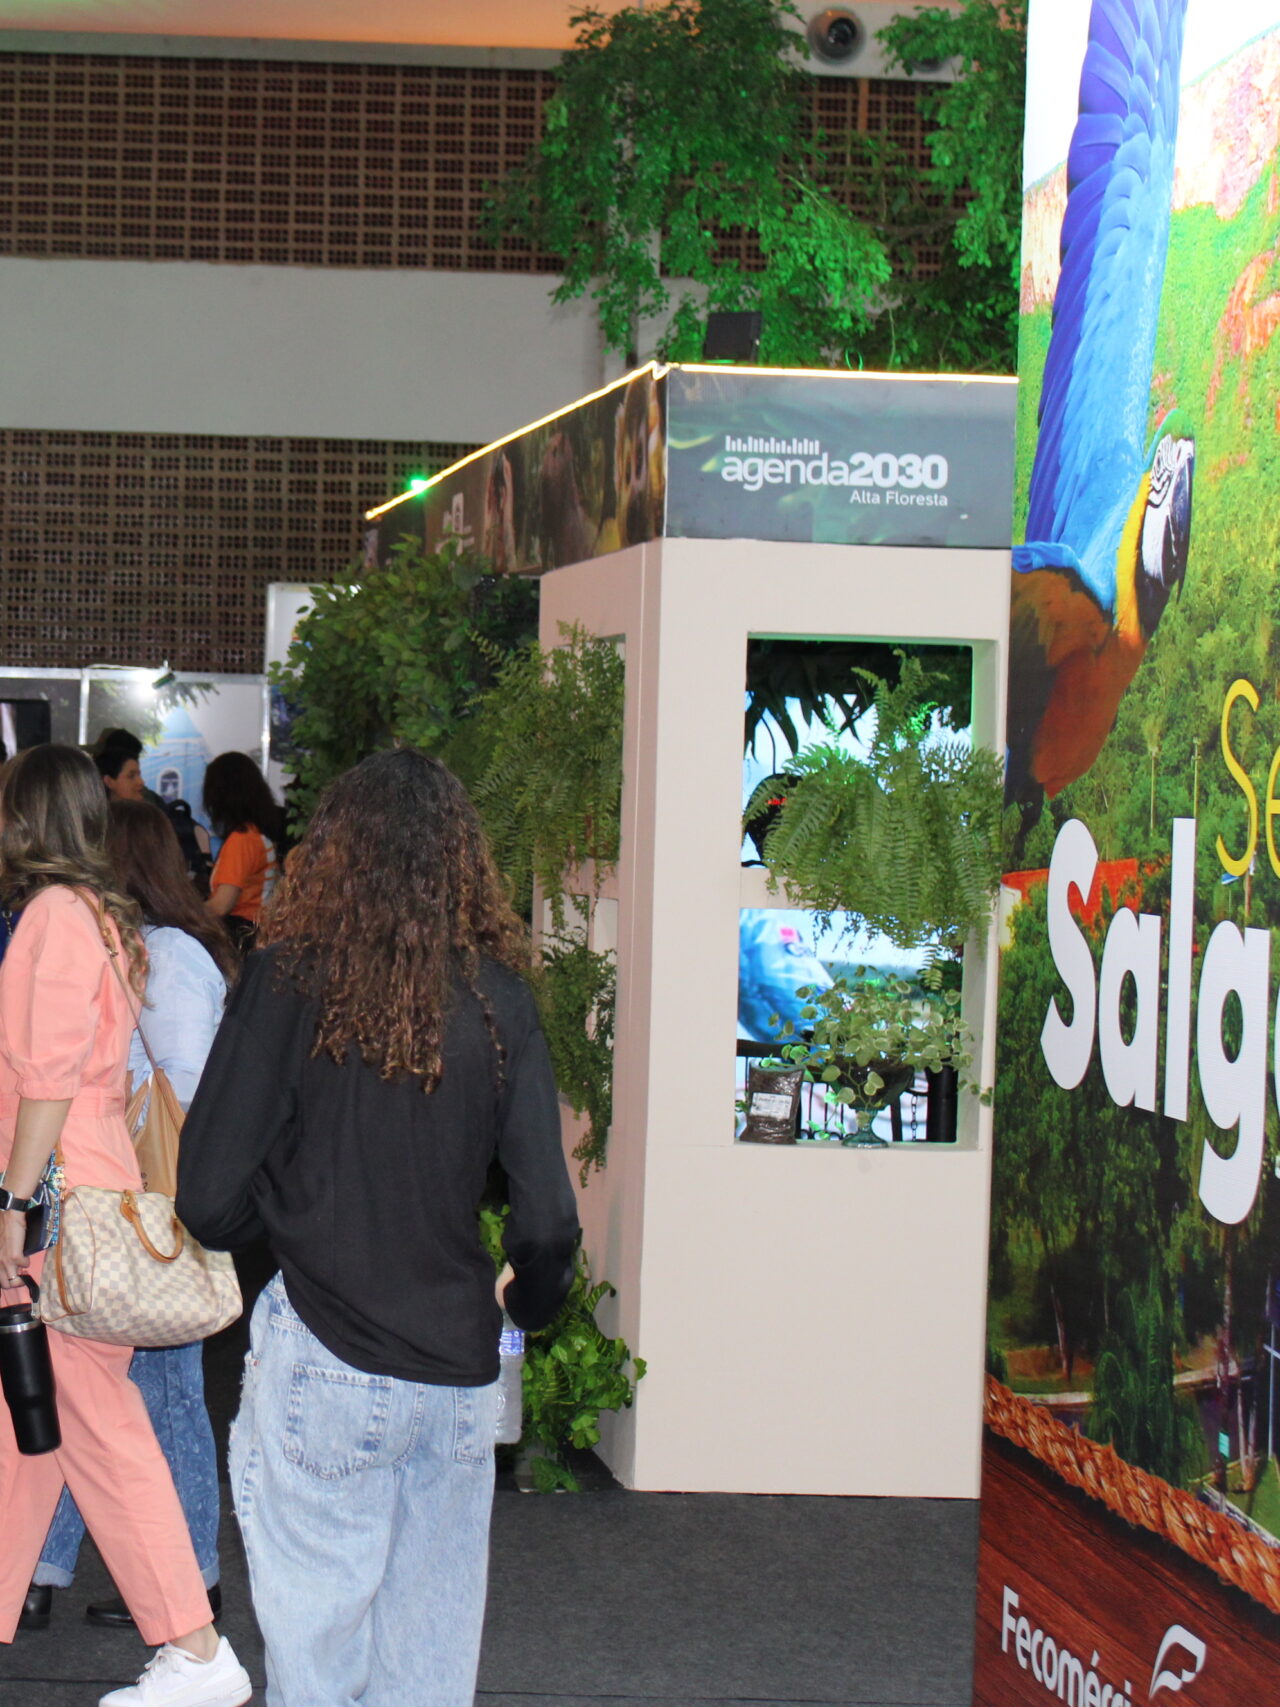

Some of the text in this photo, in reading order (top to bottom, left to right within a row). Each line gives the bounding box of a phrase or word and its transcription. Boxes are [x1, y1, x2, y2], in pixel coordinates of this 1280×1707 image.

[850, 489, 948, 507] Alta Floresta
[1041, 817, 1280, 1224] Salg
